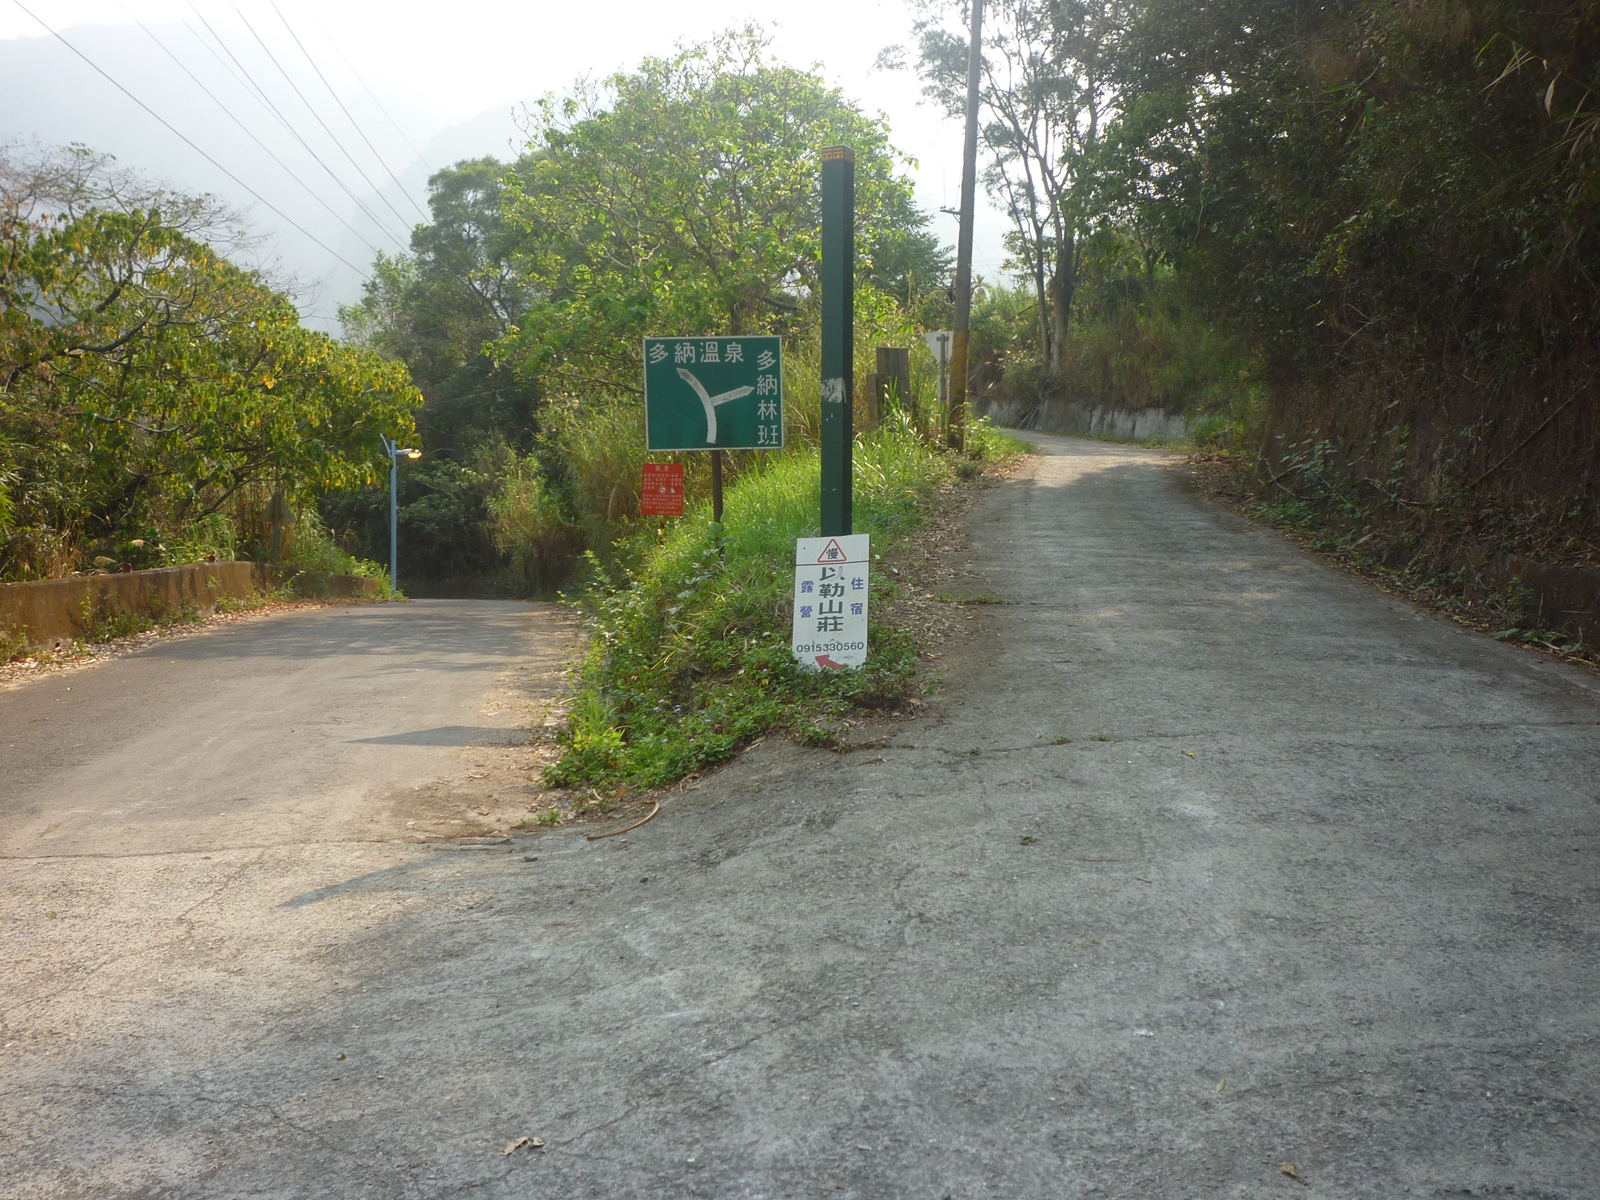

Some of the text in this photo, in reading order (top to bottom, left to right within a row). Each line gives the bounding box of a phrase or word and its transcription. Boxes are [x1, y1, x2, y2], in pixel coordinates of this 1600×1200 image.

[649, 341, 744, 364] 多納溫泉
[757, 350, 778, 445] 多納林班
[826, 548, 839, 560] 慢
[799, 580, 814, 619] 露營
[817, 566, 845, 632] 以勒山莊
[850, 577, 864, 616] 住宿
[796, 641, 864, 653] 0915330560
